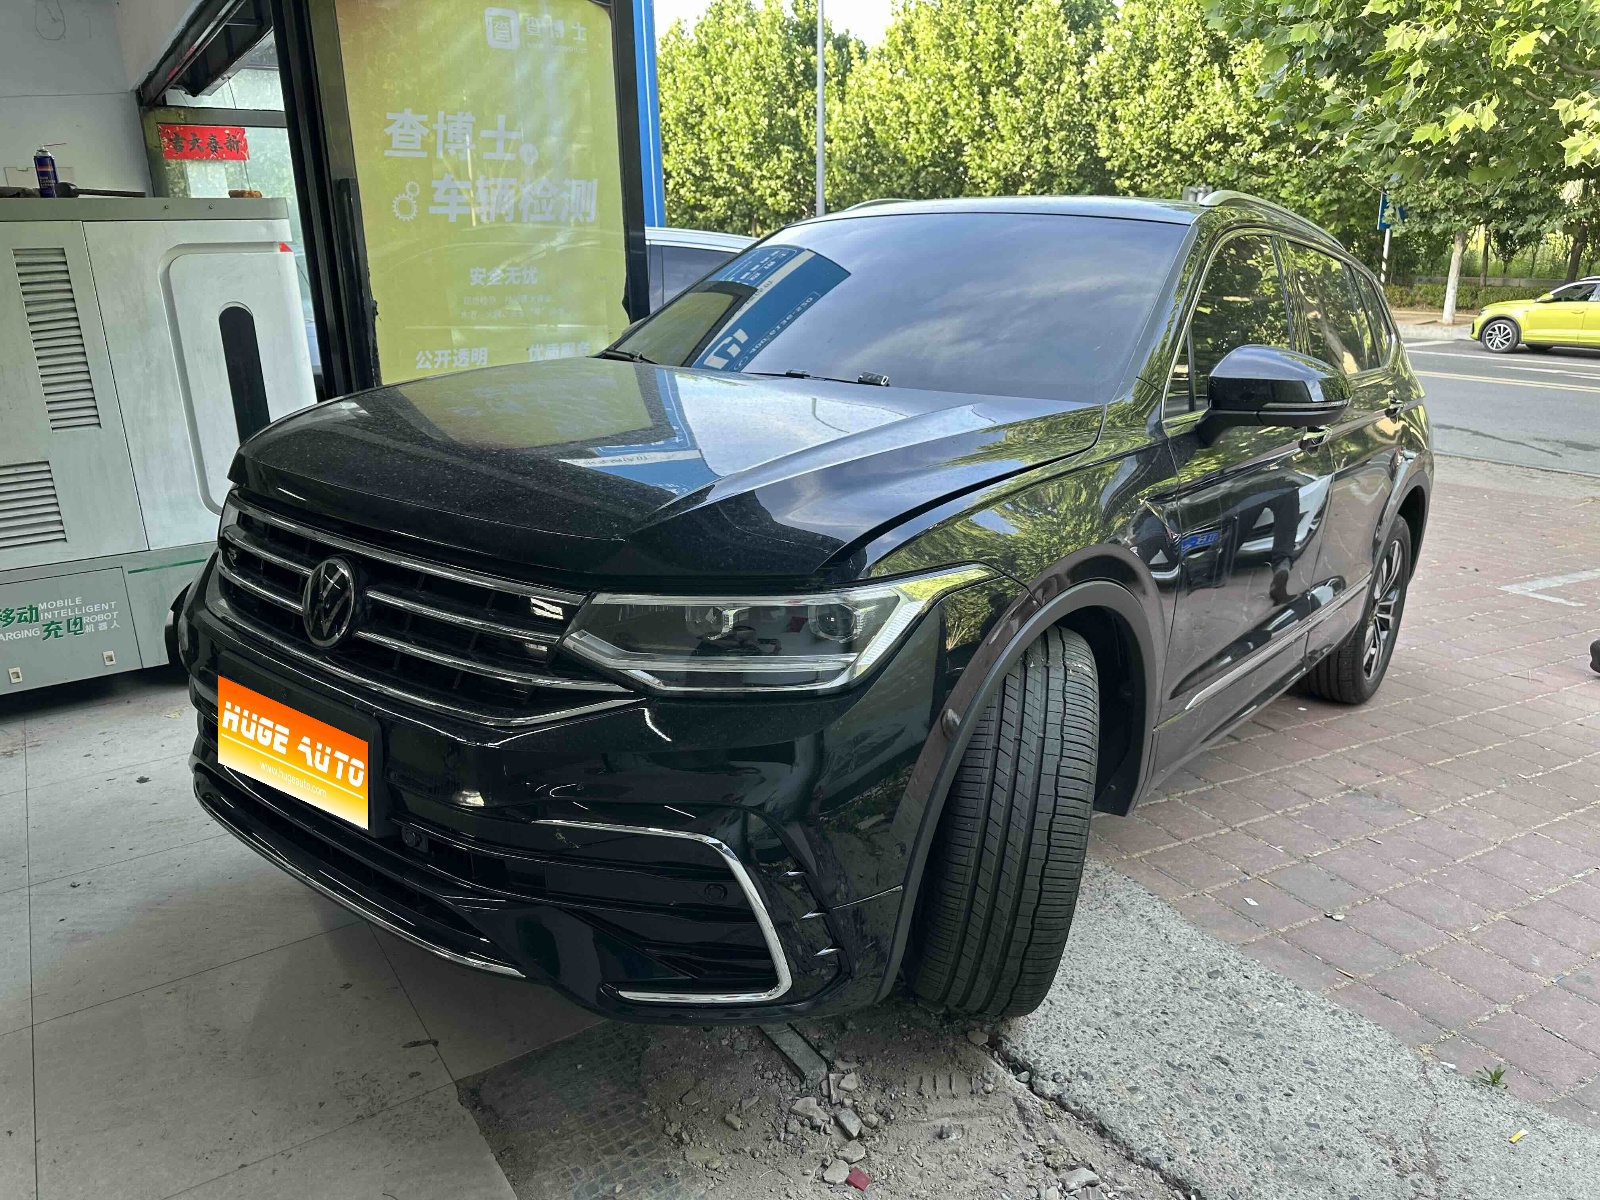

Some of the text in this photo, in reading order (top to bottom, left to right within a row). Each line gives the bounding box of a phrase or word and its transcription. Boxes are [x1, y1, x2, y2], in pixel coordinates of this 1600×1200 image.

[428, 173, 598, 223] 车辆检测
[470, 267, 538, 286] 安全无忧
[415, 347, 489, 370] 公开透明
[38, 596, 82, 610] MOBILE
[40, 601, 117, 620] INTELLIGENT
[0, 604, 39, 629] 移动
[83, 611, 119, 624] ROBOT
[42, 615, 84, 641] 充电
[84, 620, 120, 633] 机器人
